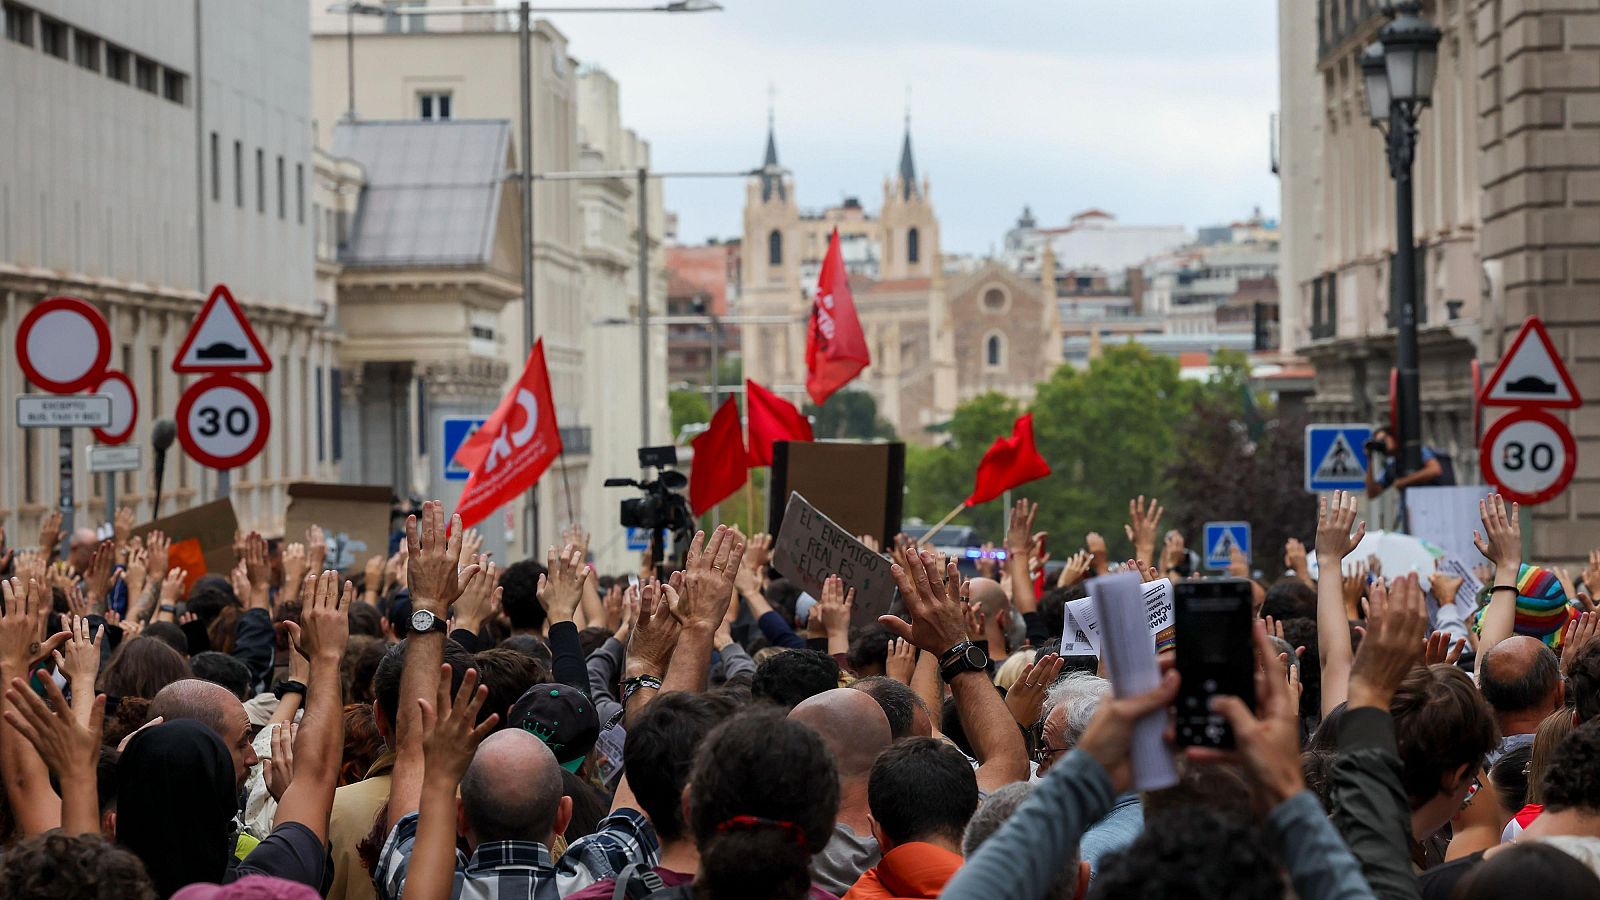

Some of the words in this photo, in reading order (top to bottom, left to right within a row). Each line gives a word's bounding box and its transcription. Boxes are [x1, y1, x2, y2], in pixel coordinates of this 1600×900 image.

[198, 406, 250, 437] 30
[1503, 441, 1555, 473] 30
[800, 508, 812, 529] EL
[821, 524, 879, 572] ENEMIGO
[800, 554, 813, 576] EL
[807, 537, 832, 569] REAL
[839, 558, 855, 580] ES
